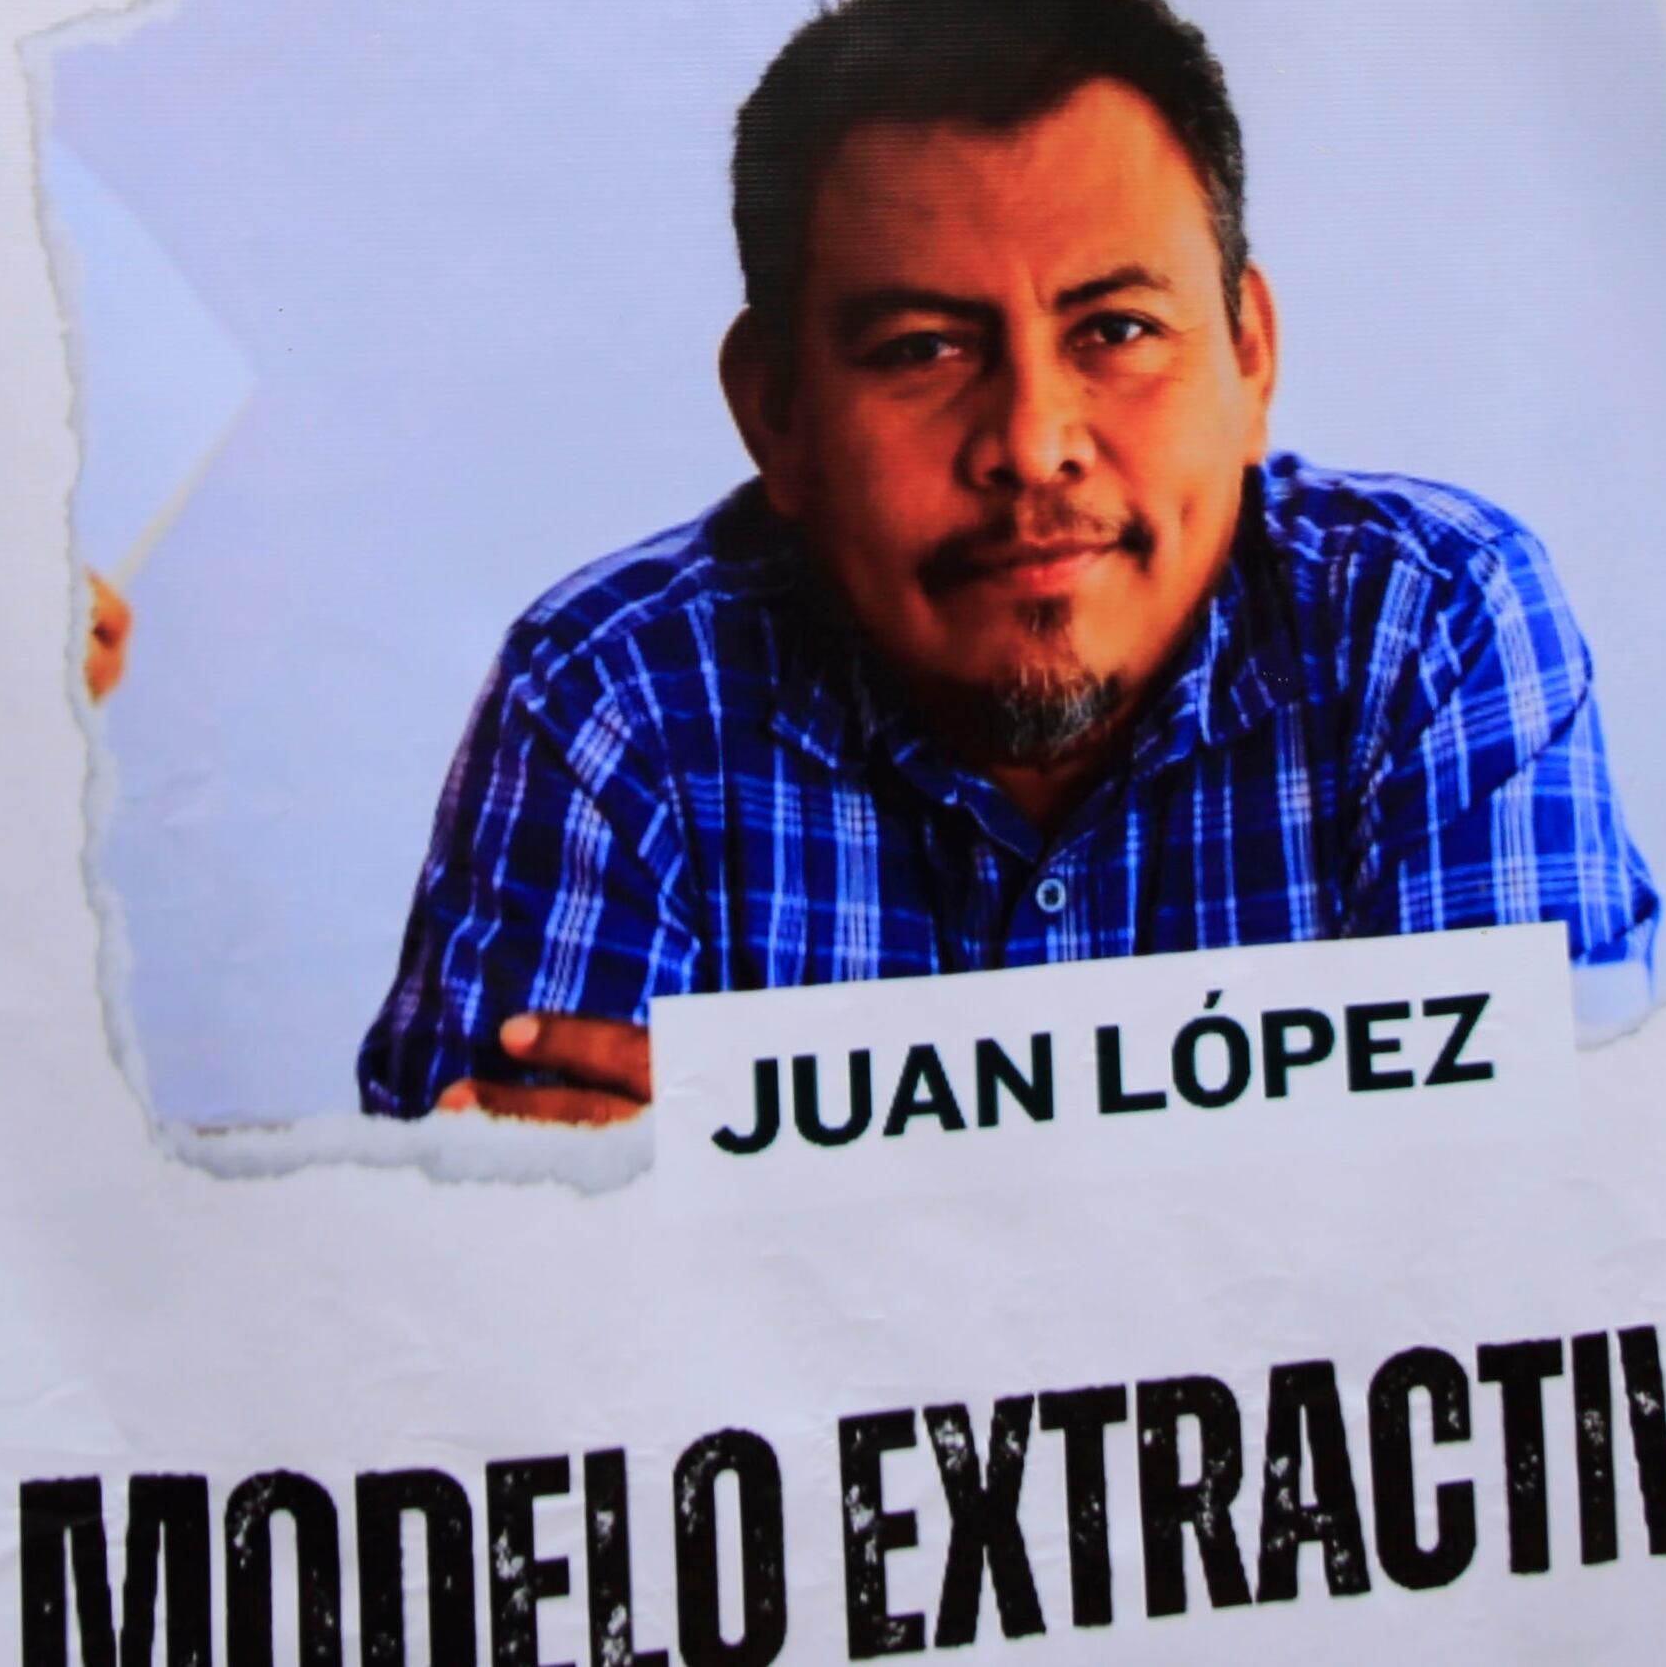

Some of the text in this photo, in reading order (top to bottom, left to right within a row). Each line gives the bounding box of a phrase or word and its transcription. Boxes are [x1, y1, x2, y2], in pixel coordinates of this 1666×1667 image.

[710, 989, 1496, 1156] JUAN LÓPEZ
[19, 1426, 788, 1667] MODELO
